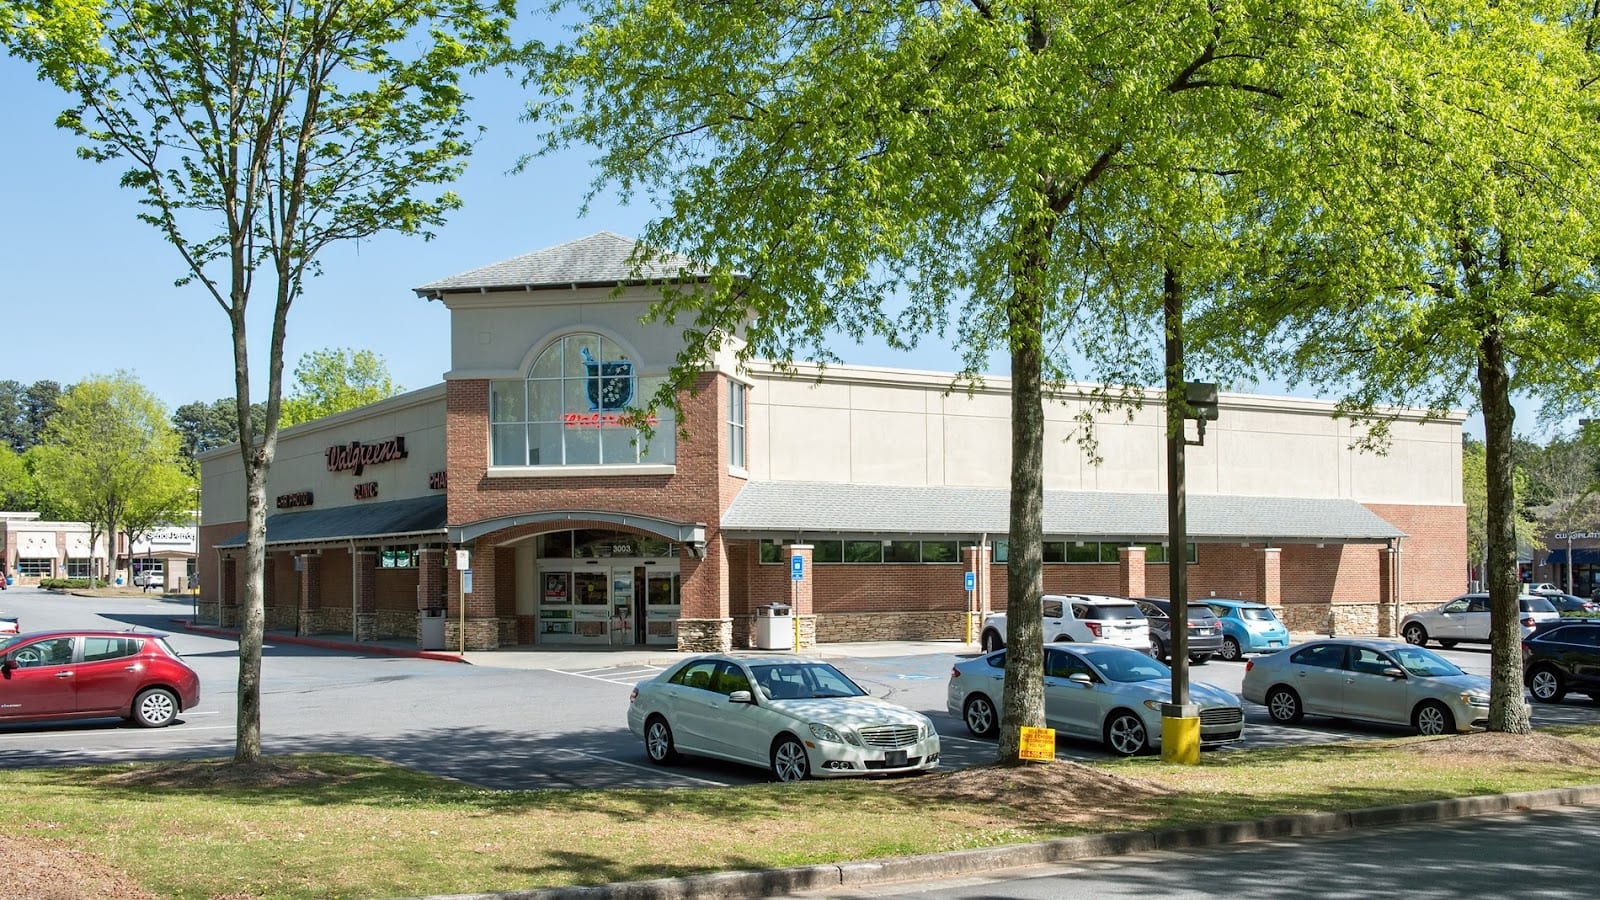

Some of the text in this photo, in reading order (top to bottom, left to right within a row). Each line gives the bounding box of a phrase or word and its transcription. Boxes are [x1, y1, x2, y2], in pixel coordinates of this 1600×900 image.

[325, 436, 407, 476] Walgreens
[429, 471, 447, 489] PHA
[354, 482, 379, 499] CLINIC
[613, 545, 631, 553] 3003
